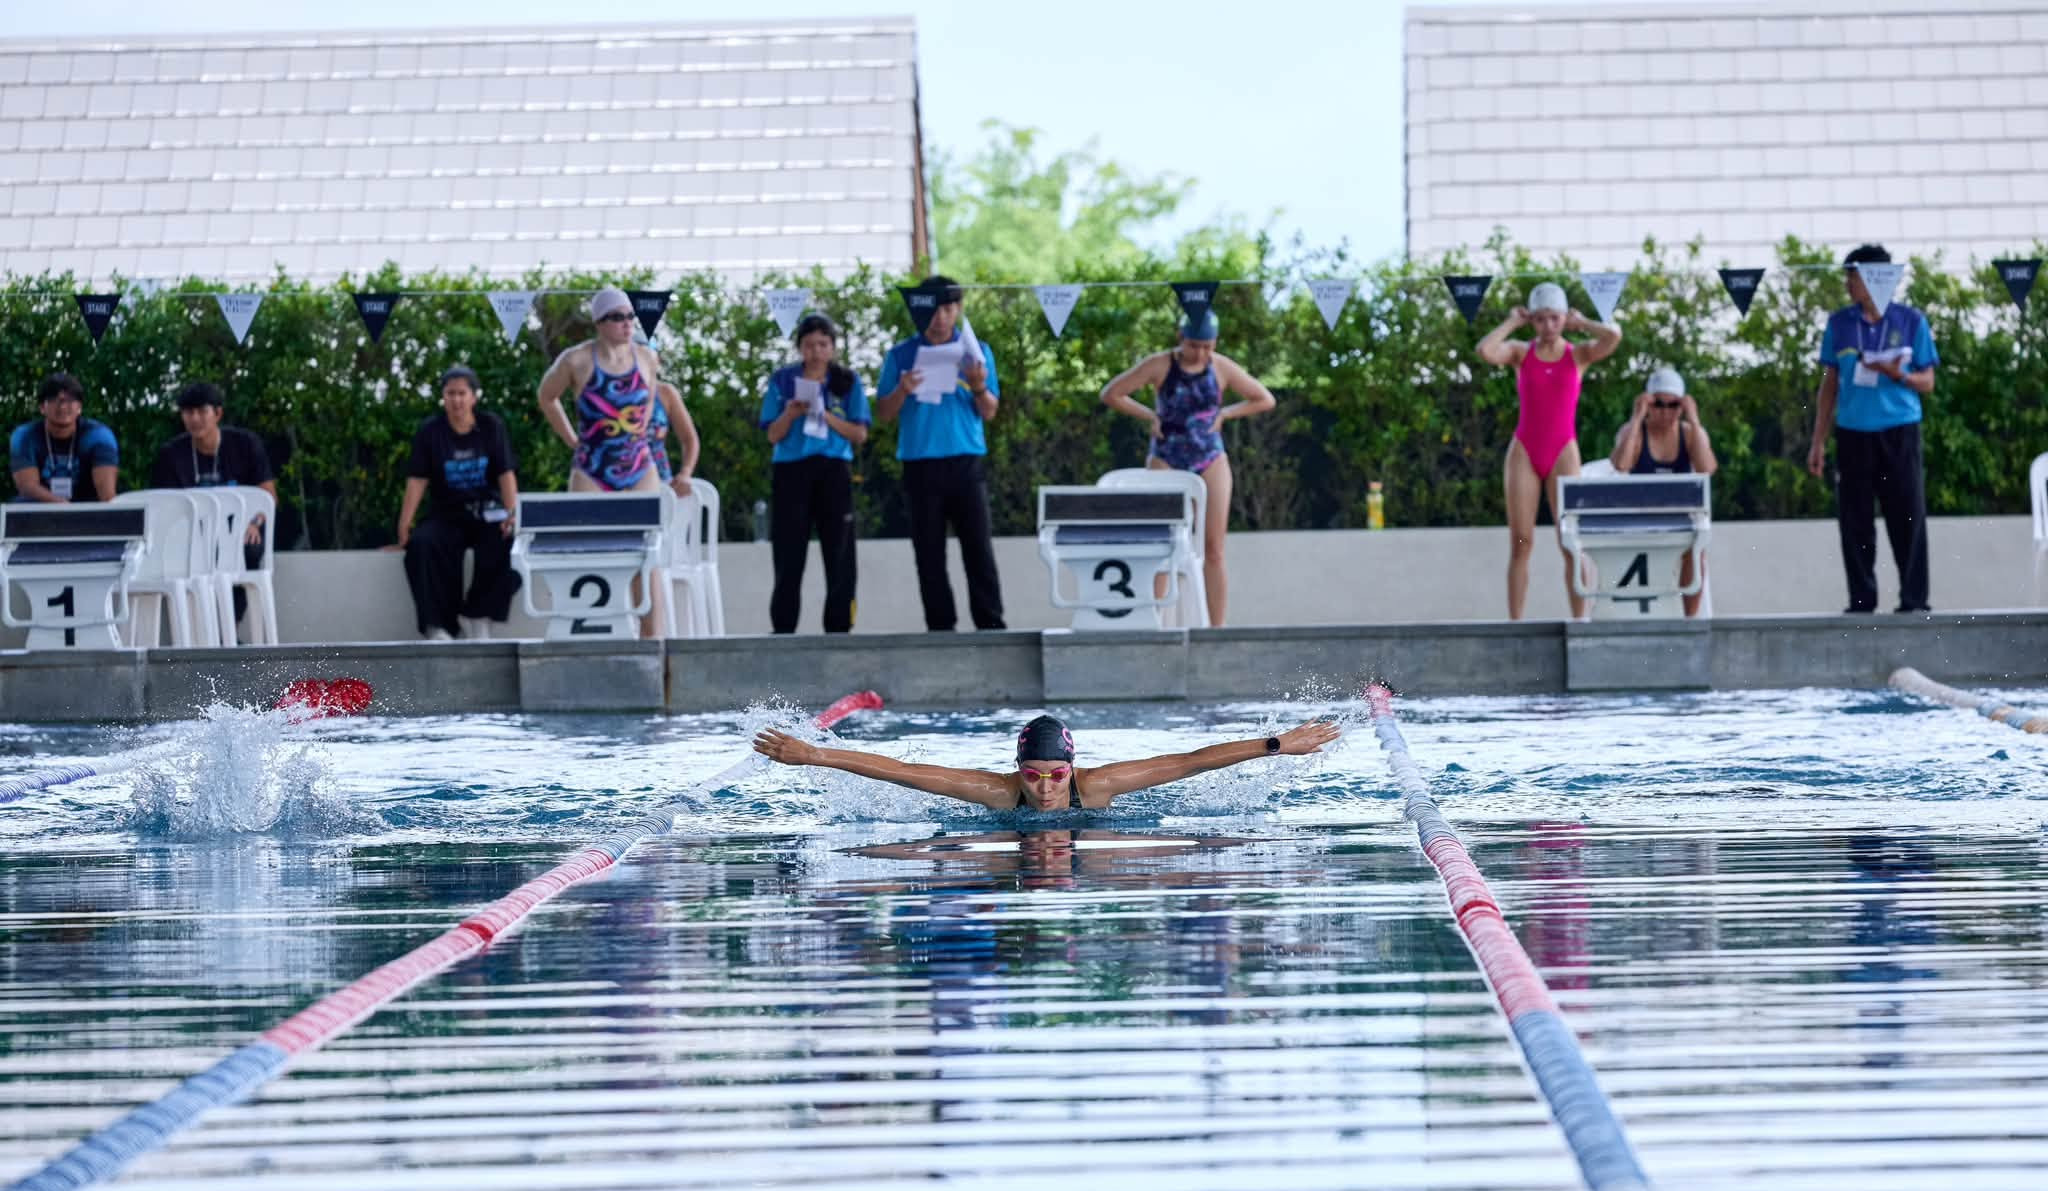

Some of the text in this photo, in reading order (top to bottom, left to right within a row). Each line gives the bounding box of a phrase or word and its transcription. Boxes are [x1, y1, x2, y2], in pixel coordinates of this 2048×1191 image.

[87, 303, 107, 314] STAGE
[365, 301, 386, 312] STAGE
[639, 299, 660, 310] STAGE
[569, 573, 612, 635] 2
[1093, 559, 1136, 618] 3
[1612, 553, 1658, 613] 4
[47, 586, 75, 646] 1
